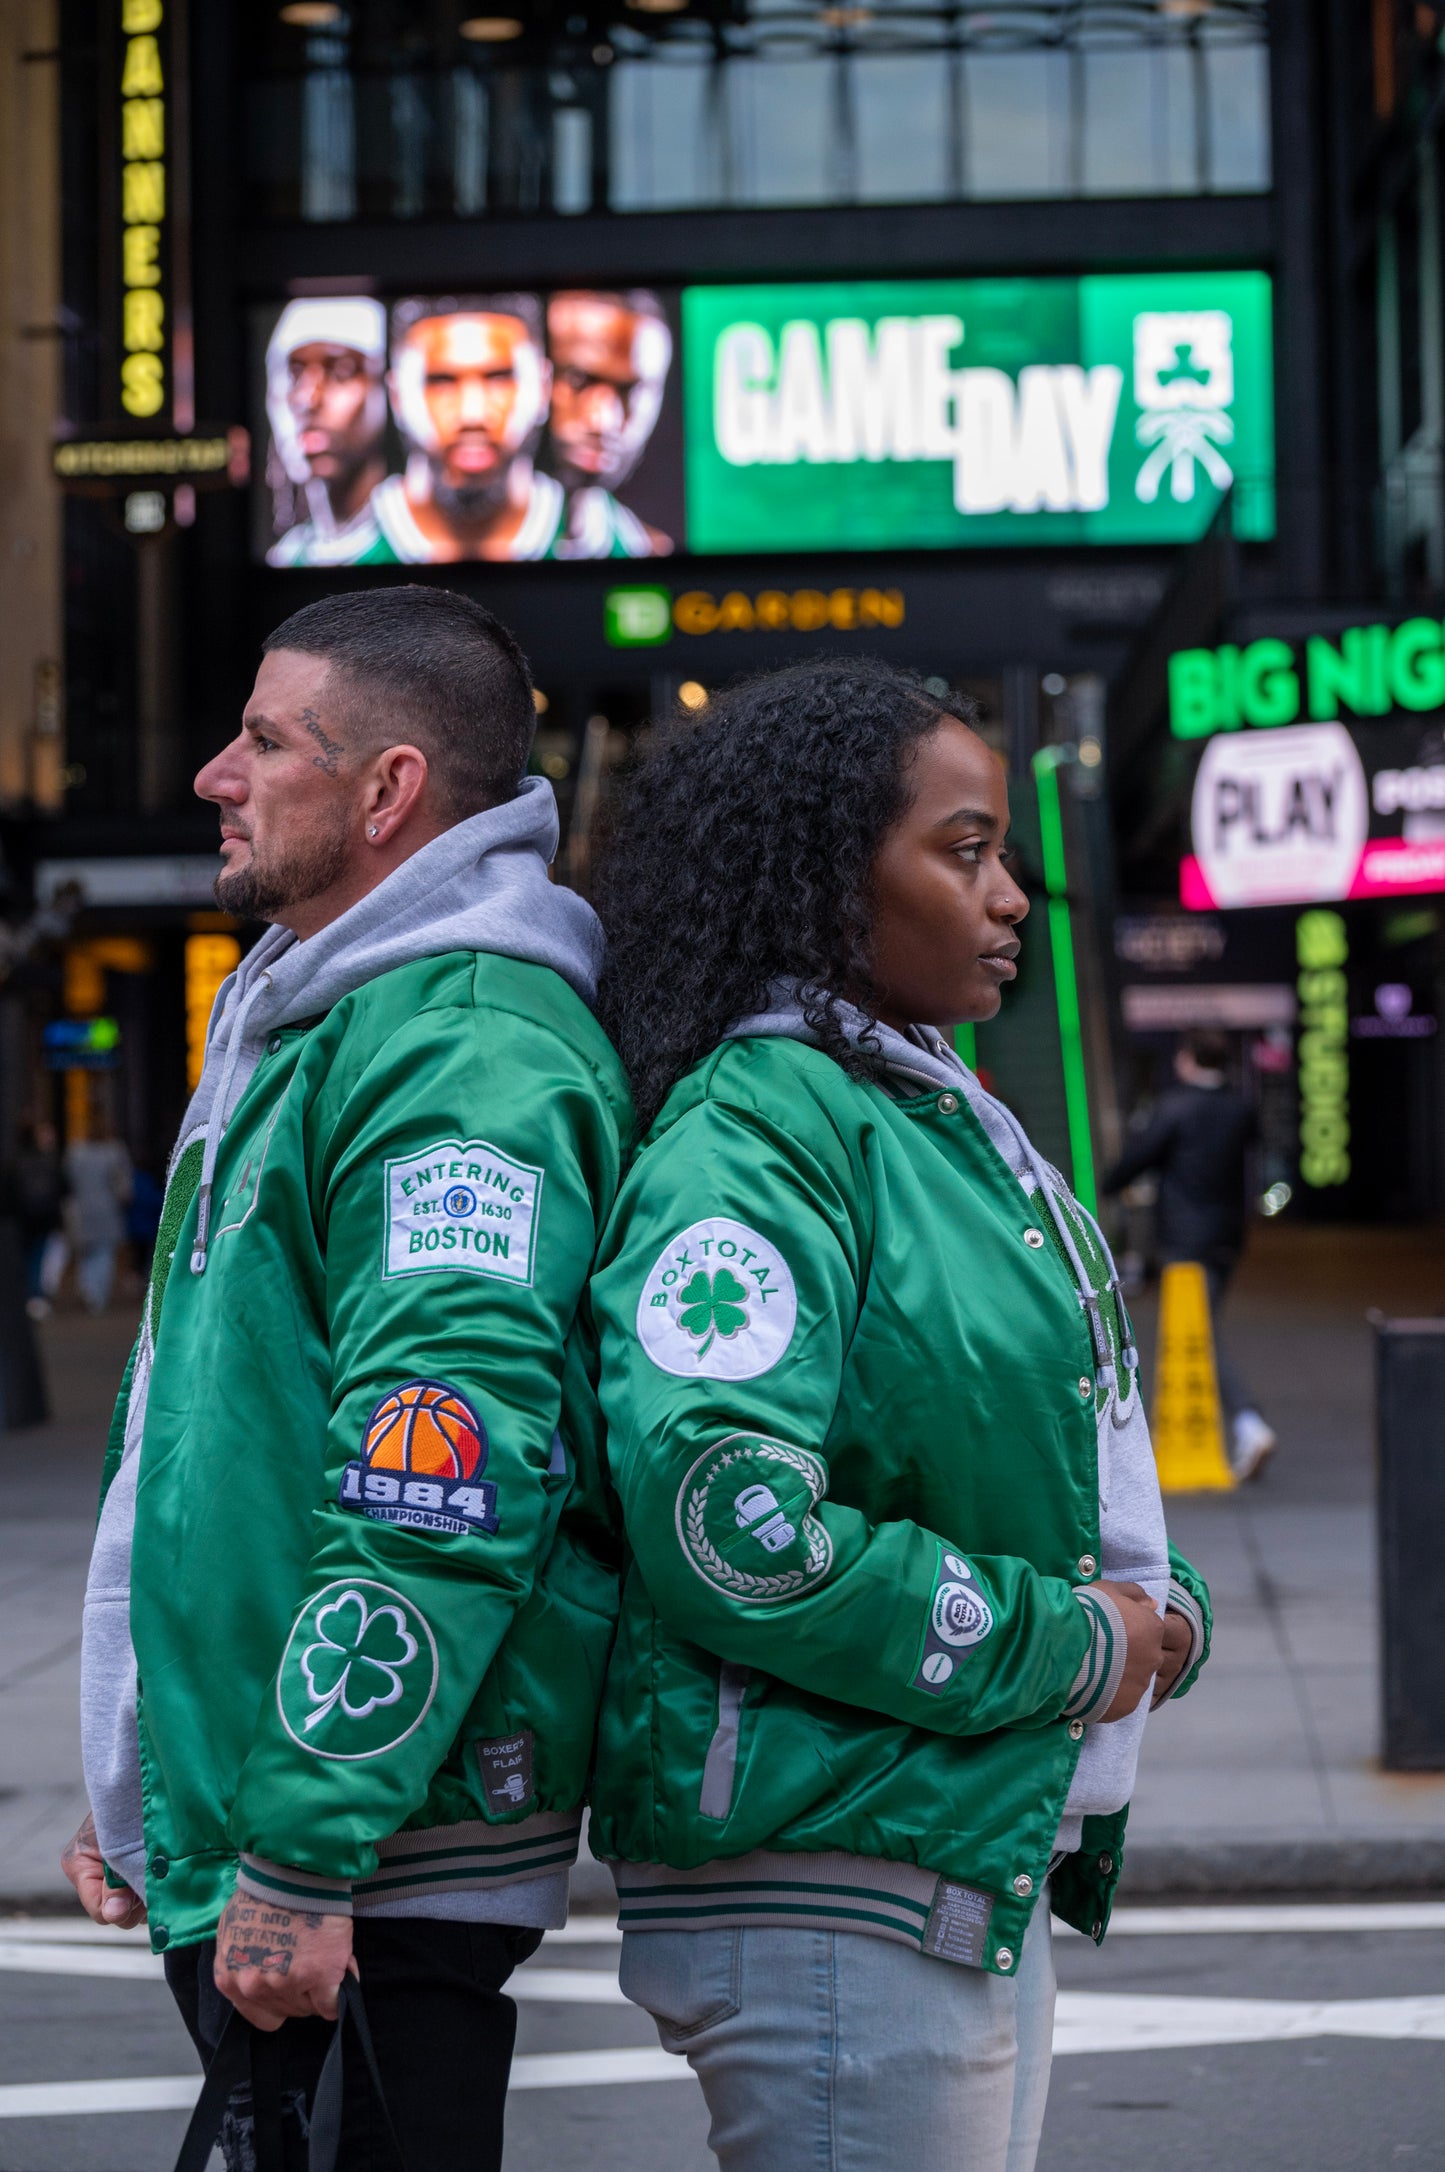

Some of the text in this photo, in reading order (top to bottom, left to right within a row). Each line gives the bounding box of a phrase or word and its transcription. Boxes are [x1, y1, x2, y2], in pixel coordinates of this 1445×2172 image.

[713, 314, 965, 466] GAME
[952, 363, 1124, 514] DAY
[605, 587, 905, 641] TD GARDEN
[1168, 637, 1300, 740] BIG
[1214, 762, 1346, 858] PLAY
[400, 1161, 525, 1203] ENTERING
[413, 1199, 512, 1220] EST. 1630
[409, 1226, 510, 1260] BOSTON
[649, 1238, 779, 1308] BOX TOTAL
[342, 1468, 487, 1520] 1984
[363, 1507, 469, 1535] CHAMPIONSHIP
[953, 1603, 962, 1619] BOX
[958, 1602, 968, 1625] TOTAL
[483, 1738, 525, 1756] BOXER'S
[946, 1886, 962, 1897] BOX
[963, 1891, 987, 1904] TOTAL
[229, 1924, 298, 1948] TEMPTATION
[260, 1911, 291, 1928] INTO
